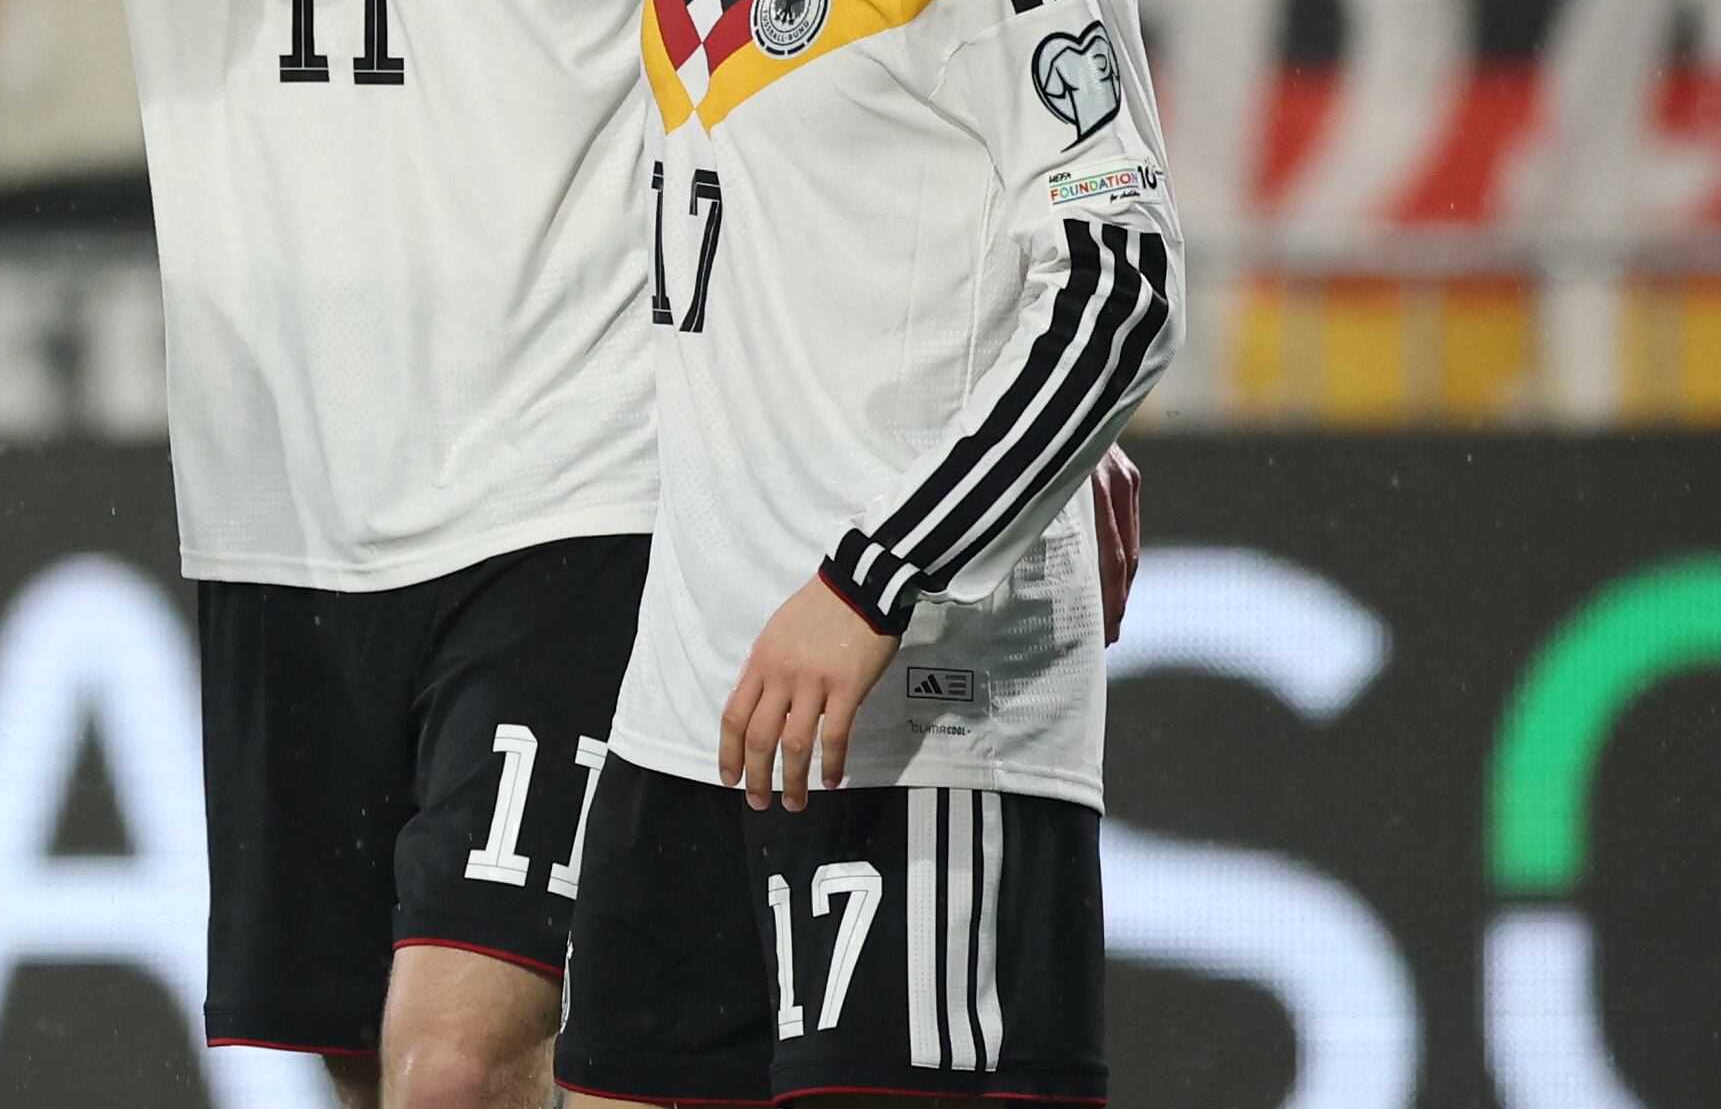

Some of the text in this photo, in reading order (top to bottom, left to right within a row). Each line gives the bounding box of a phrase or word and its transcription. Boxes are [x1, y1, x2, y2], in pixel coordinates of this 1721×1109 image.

[651, 160, 723, 333] 17
[1049, 172, 1072, 183] UEFA
[1050, 171, 1139, 201] FOUNDATION
[464, 723, 608, 900] 11
[768, 860, 883, 1041] 17
